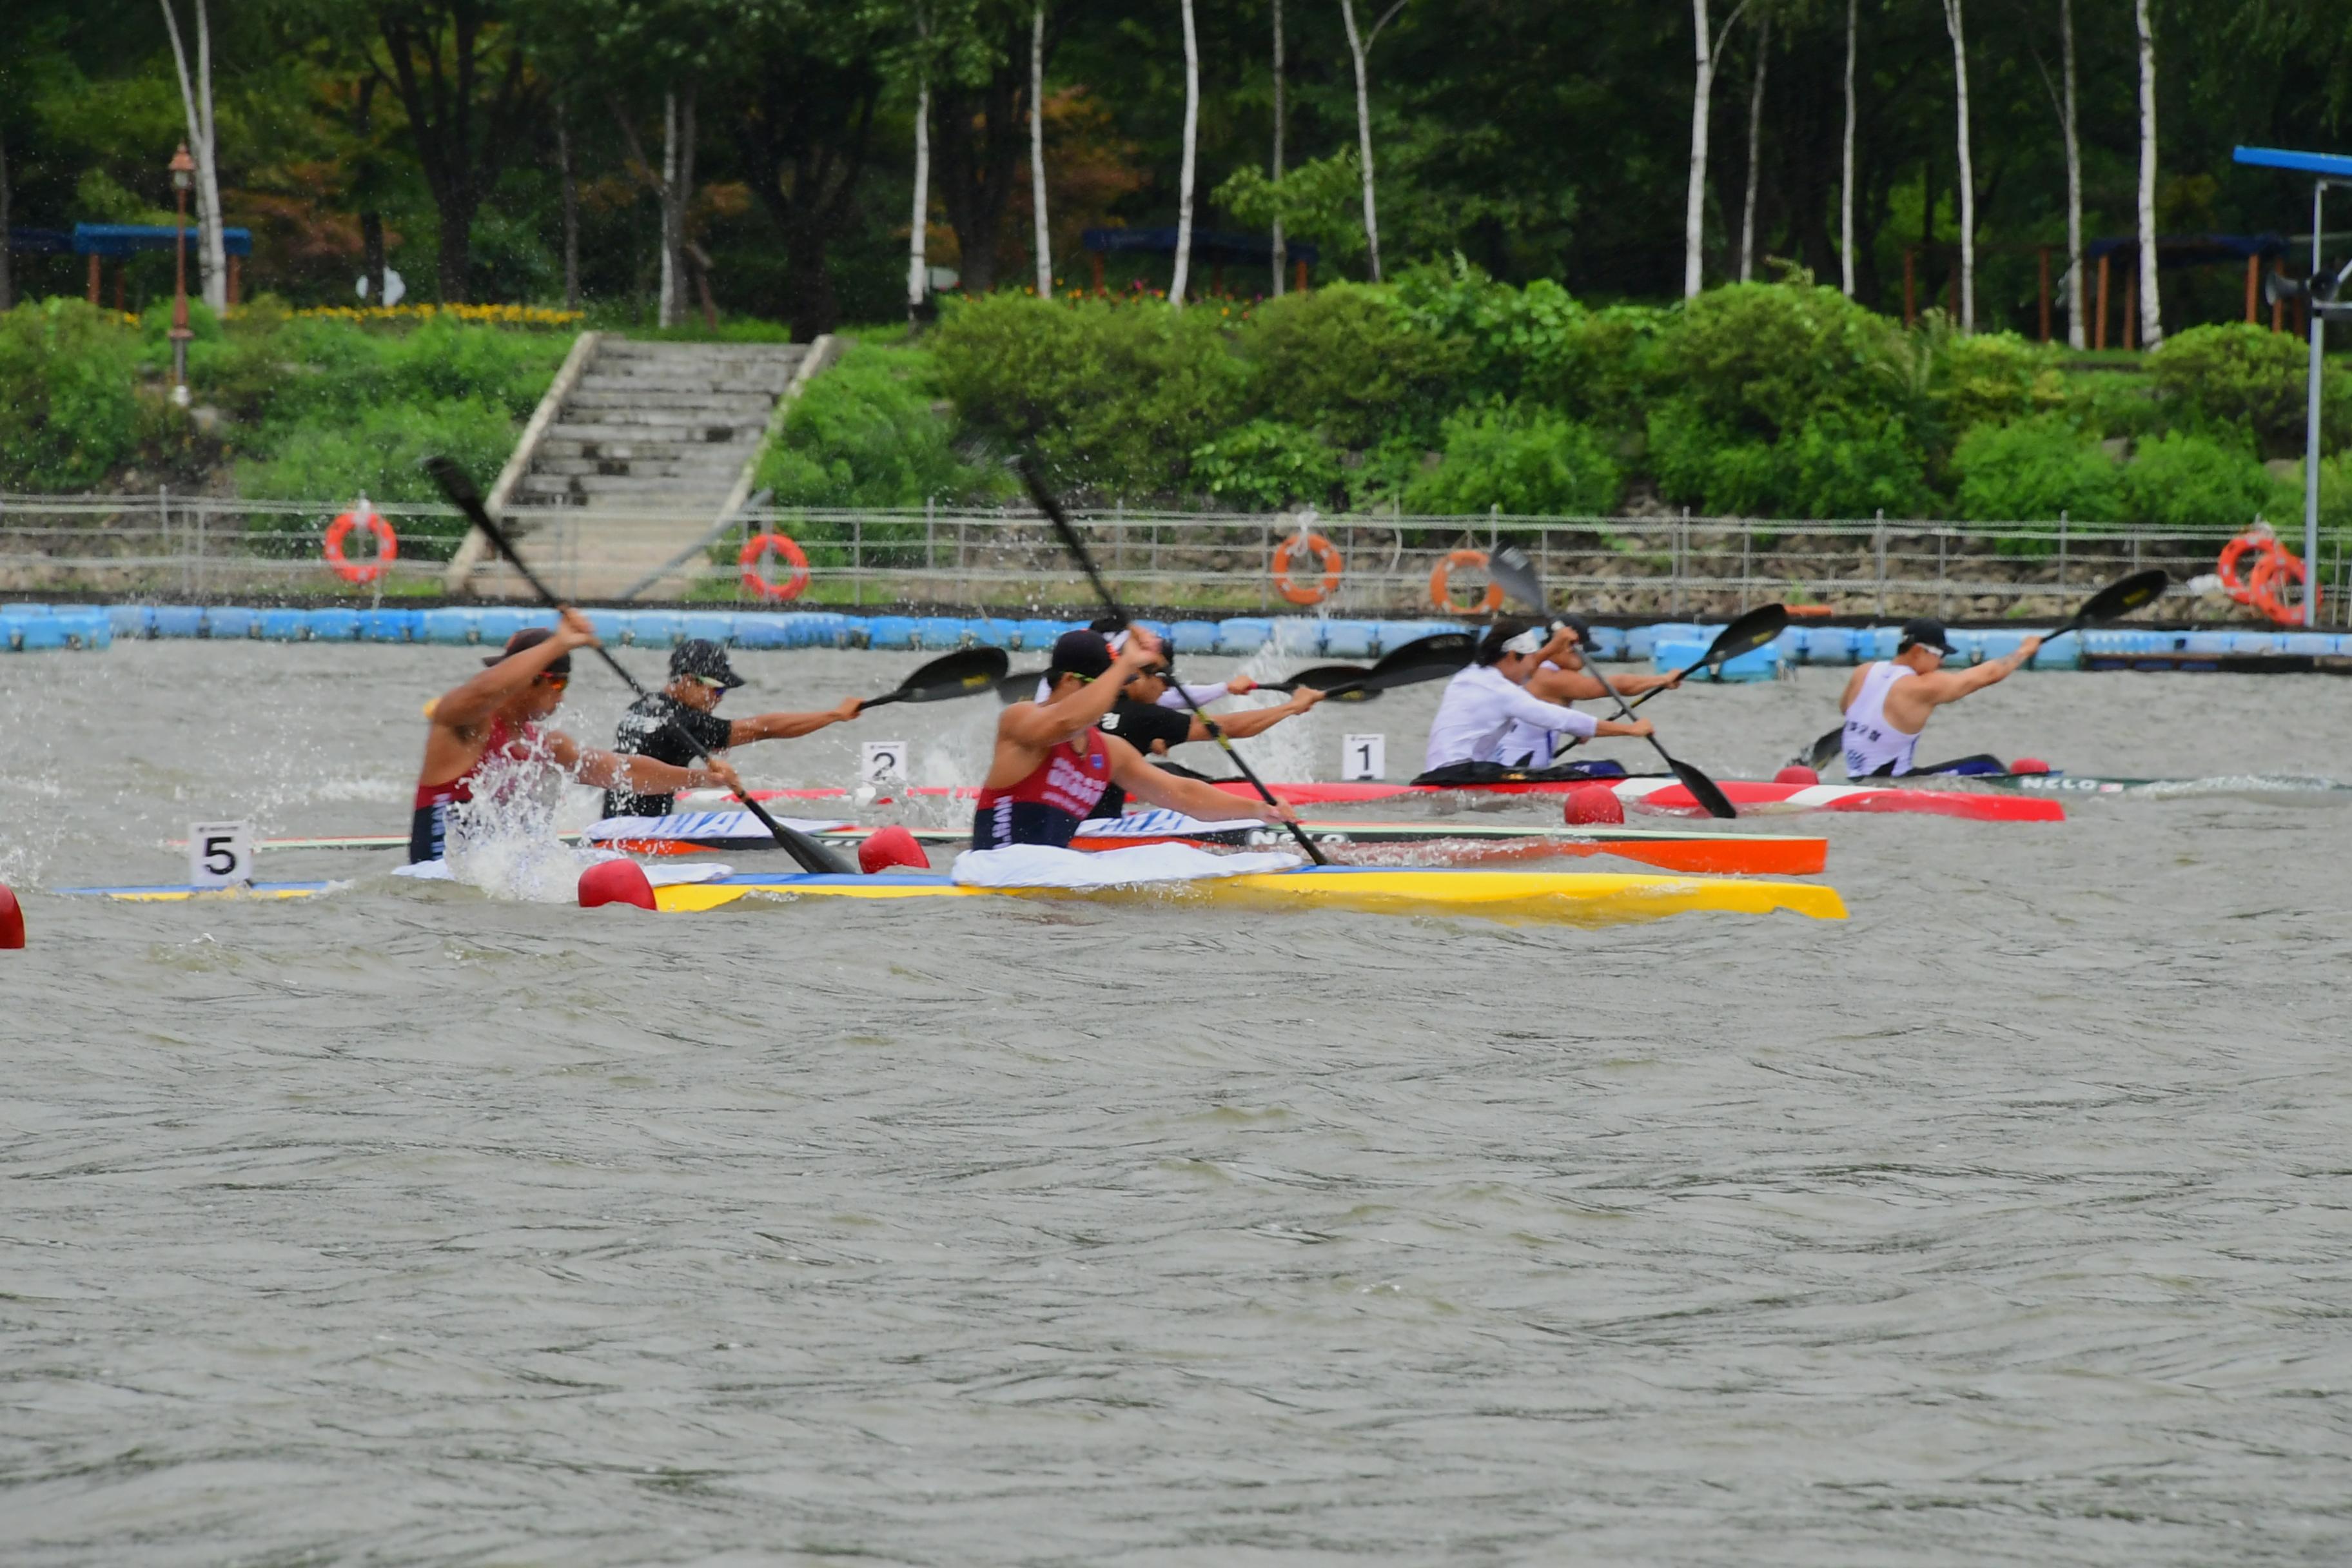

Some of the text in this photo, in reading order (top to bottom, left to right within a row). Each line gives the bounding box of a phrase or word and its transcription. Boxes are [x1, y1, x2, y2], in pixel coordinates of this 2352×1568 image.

[872, 752, 895, 781] 2
[1357, 743, 1369, 771] 1
[2021, 777, 2097, 790] NELO
[205, 837, 236, 875] 5
